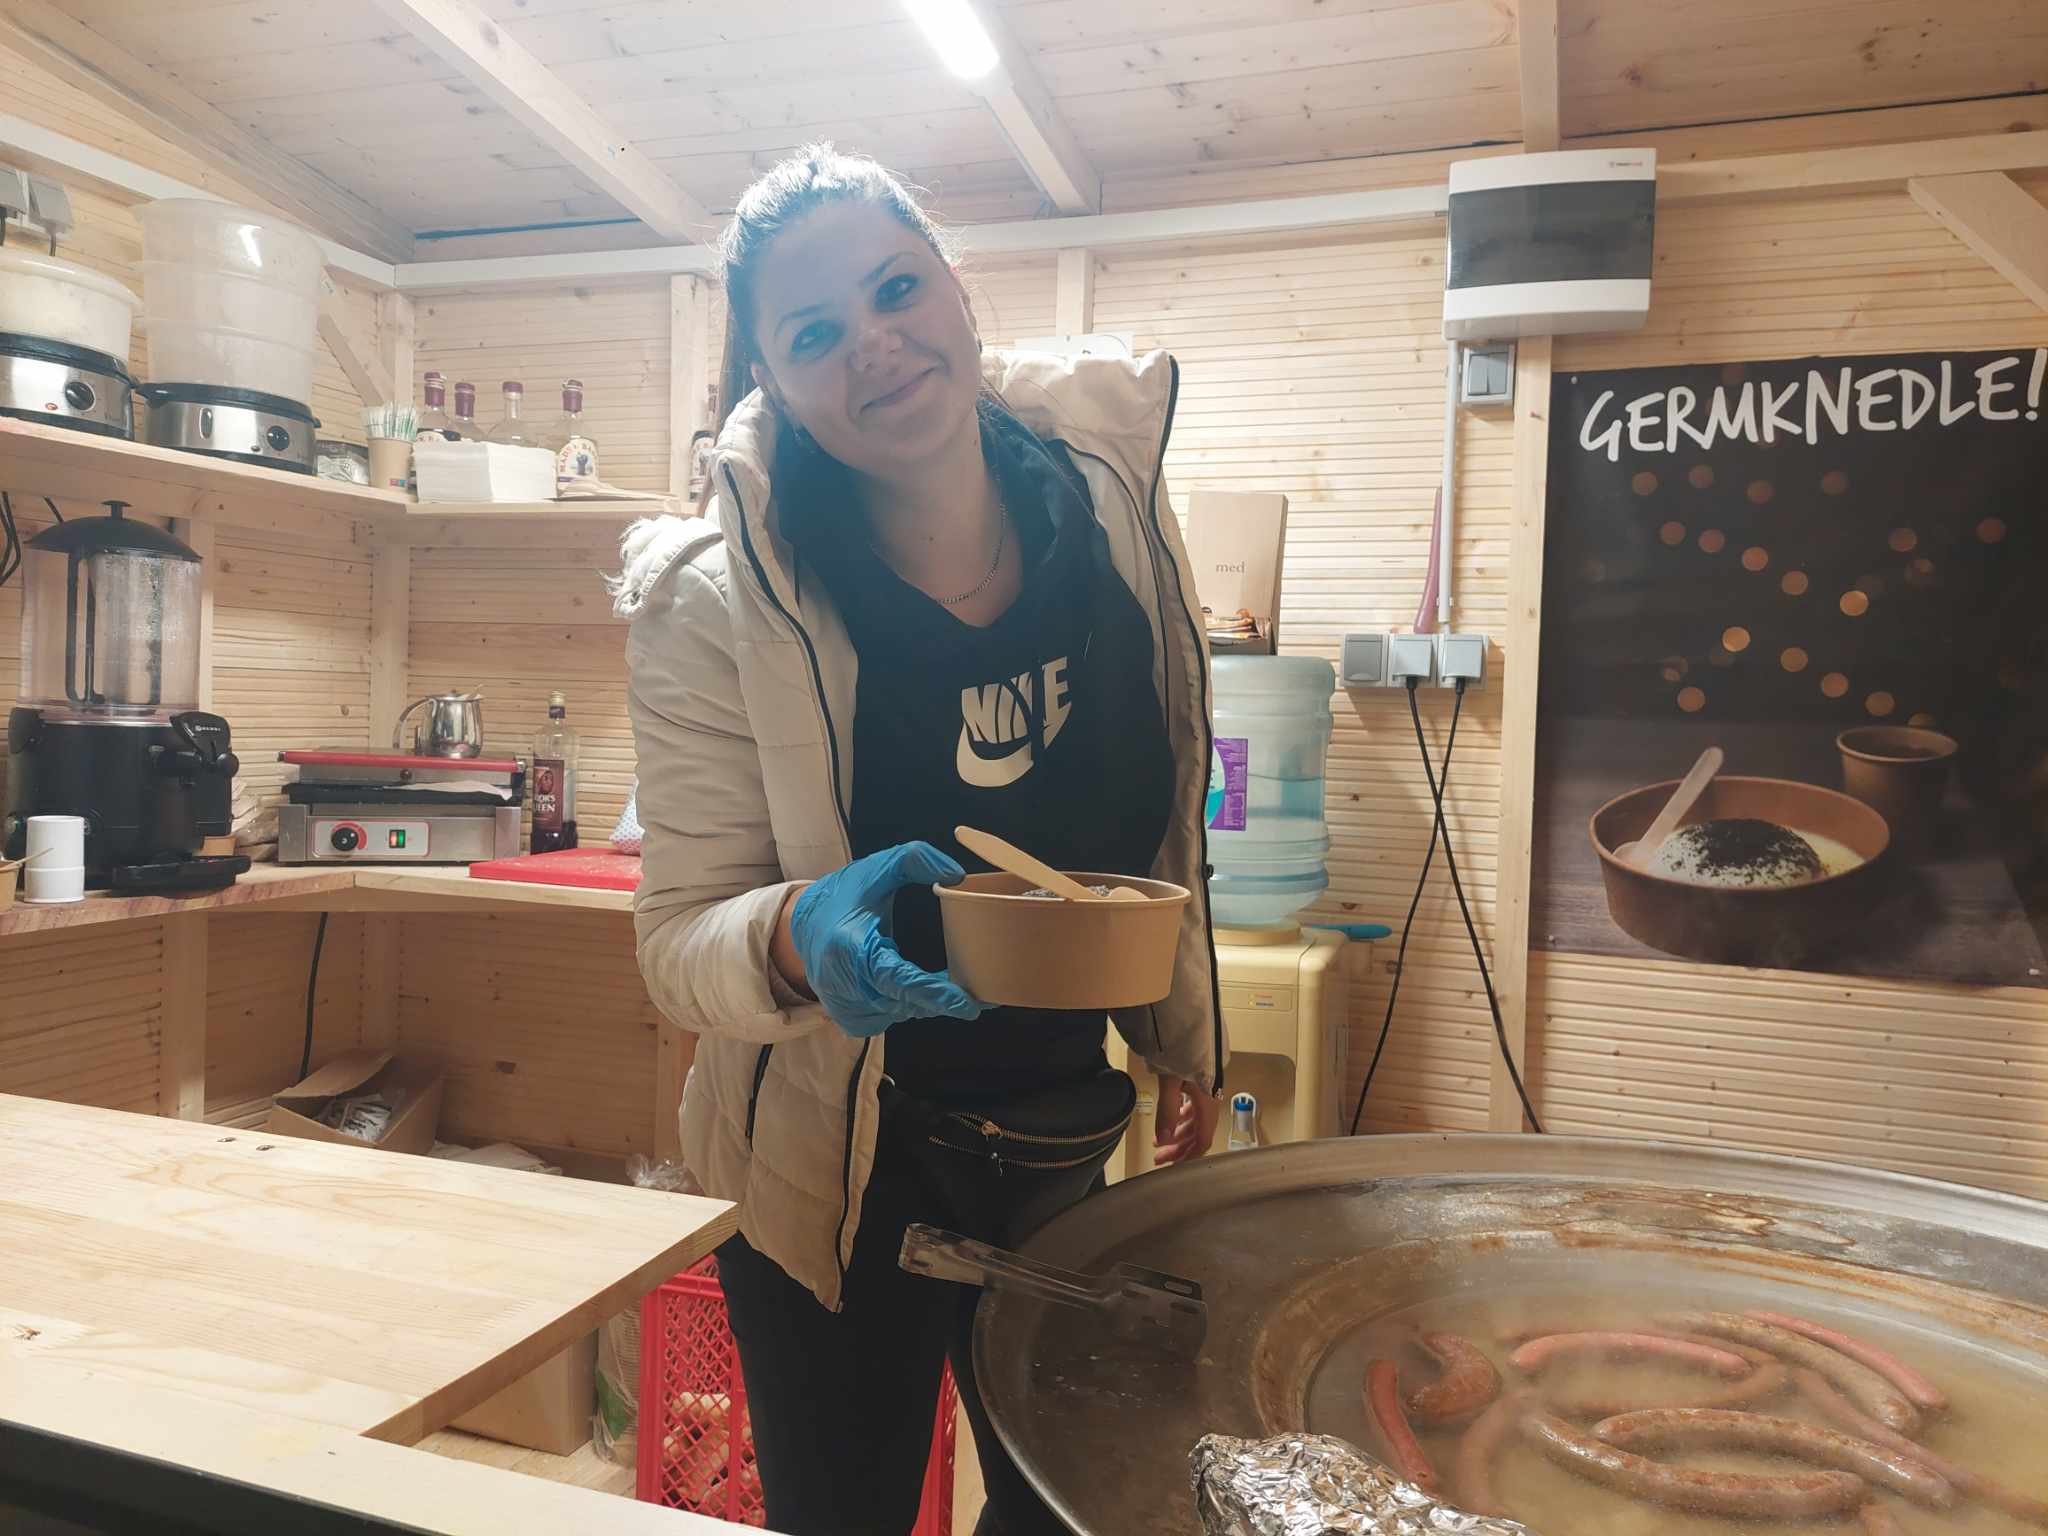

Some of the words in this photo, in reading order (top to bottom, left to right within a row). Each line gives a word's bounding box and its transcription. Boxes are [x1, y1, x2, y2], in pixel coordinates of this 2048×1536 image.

[1579, 348, 2048, 462] GERMKNEDLE!
[1216, 560, 1245, 573] med
[961, 656, 1073, 746] NIKE
